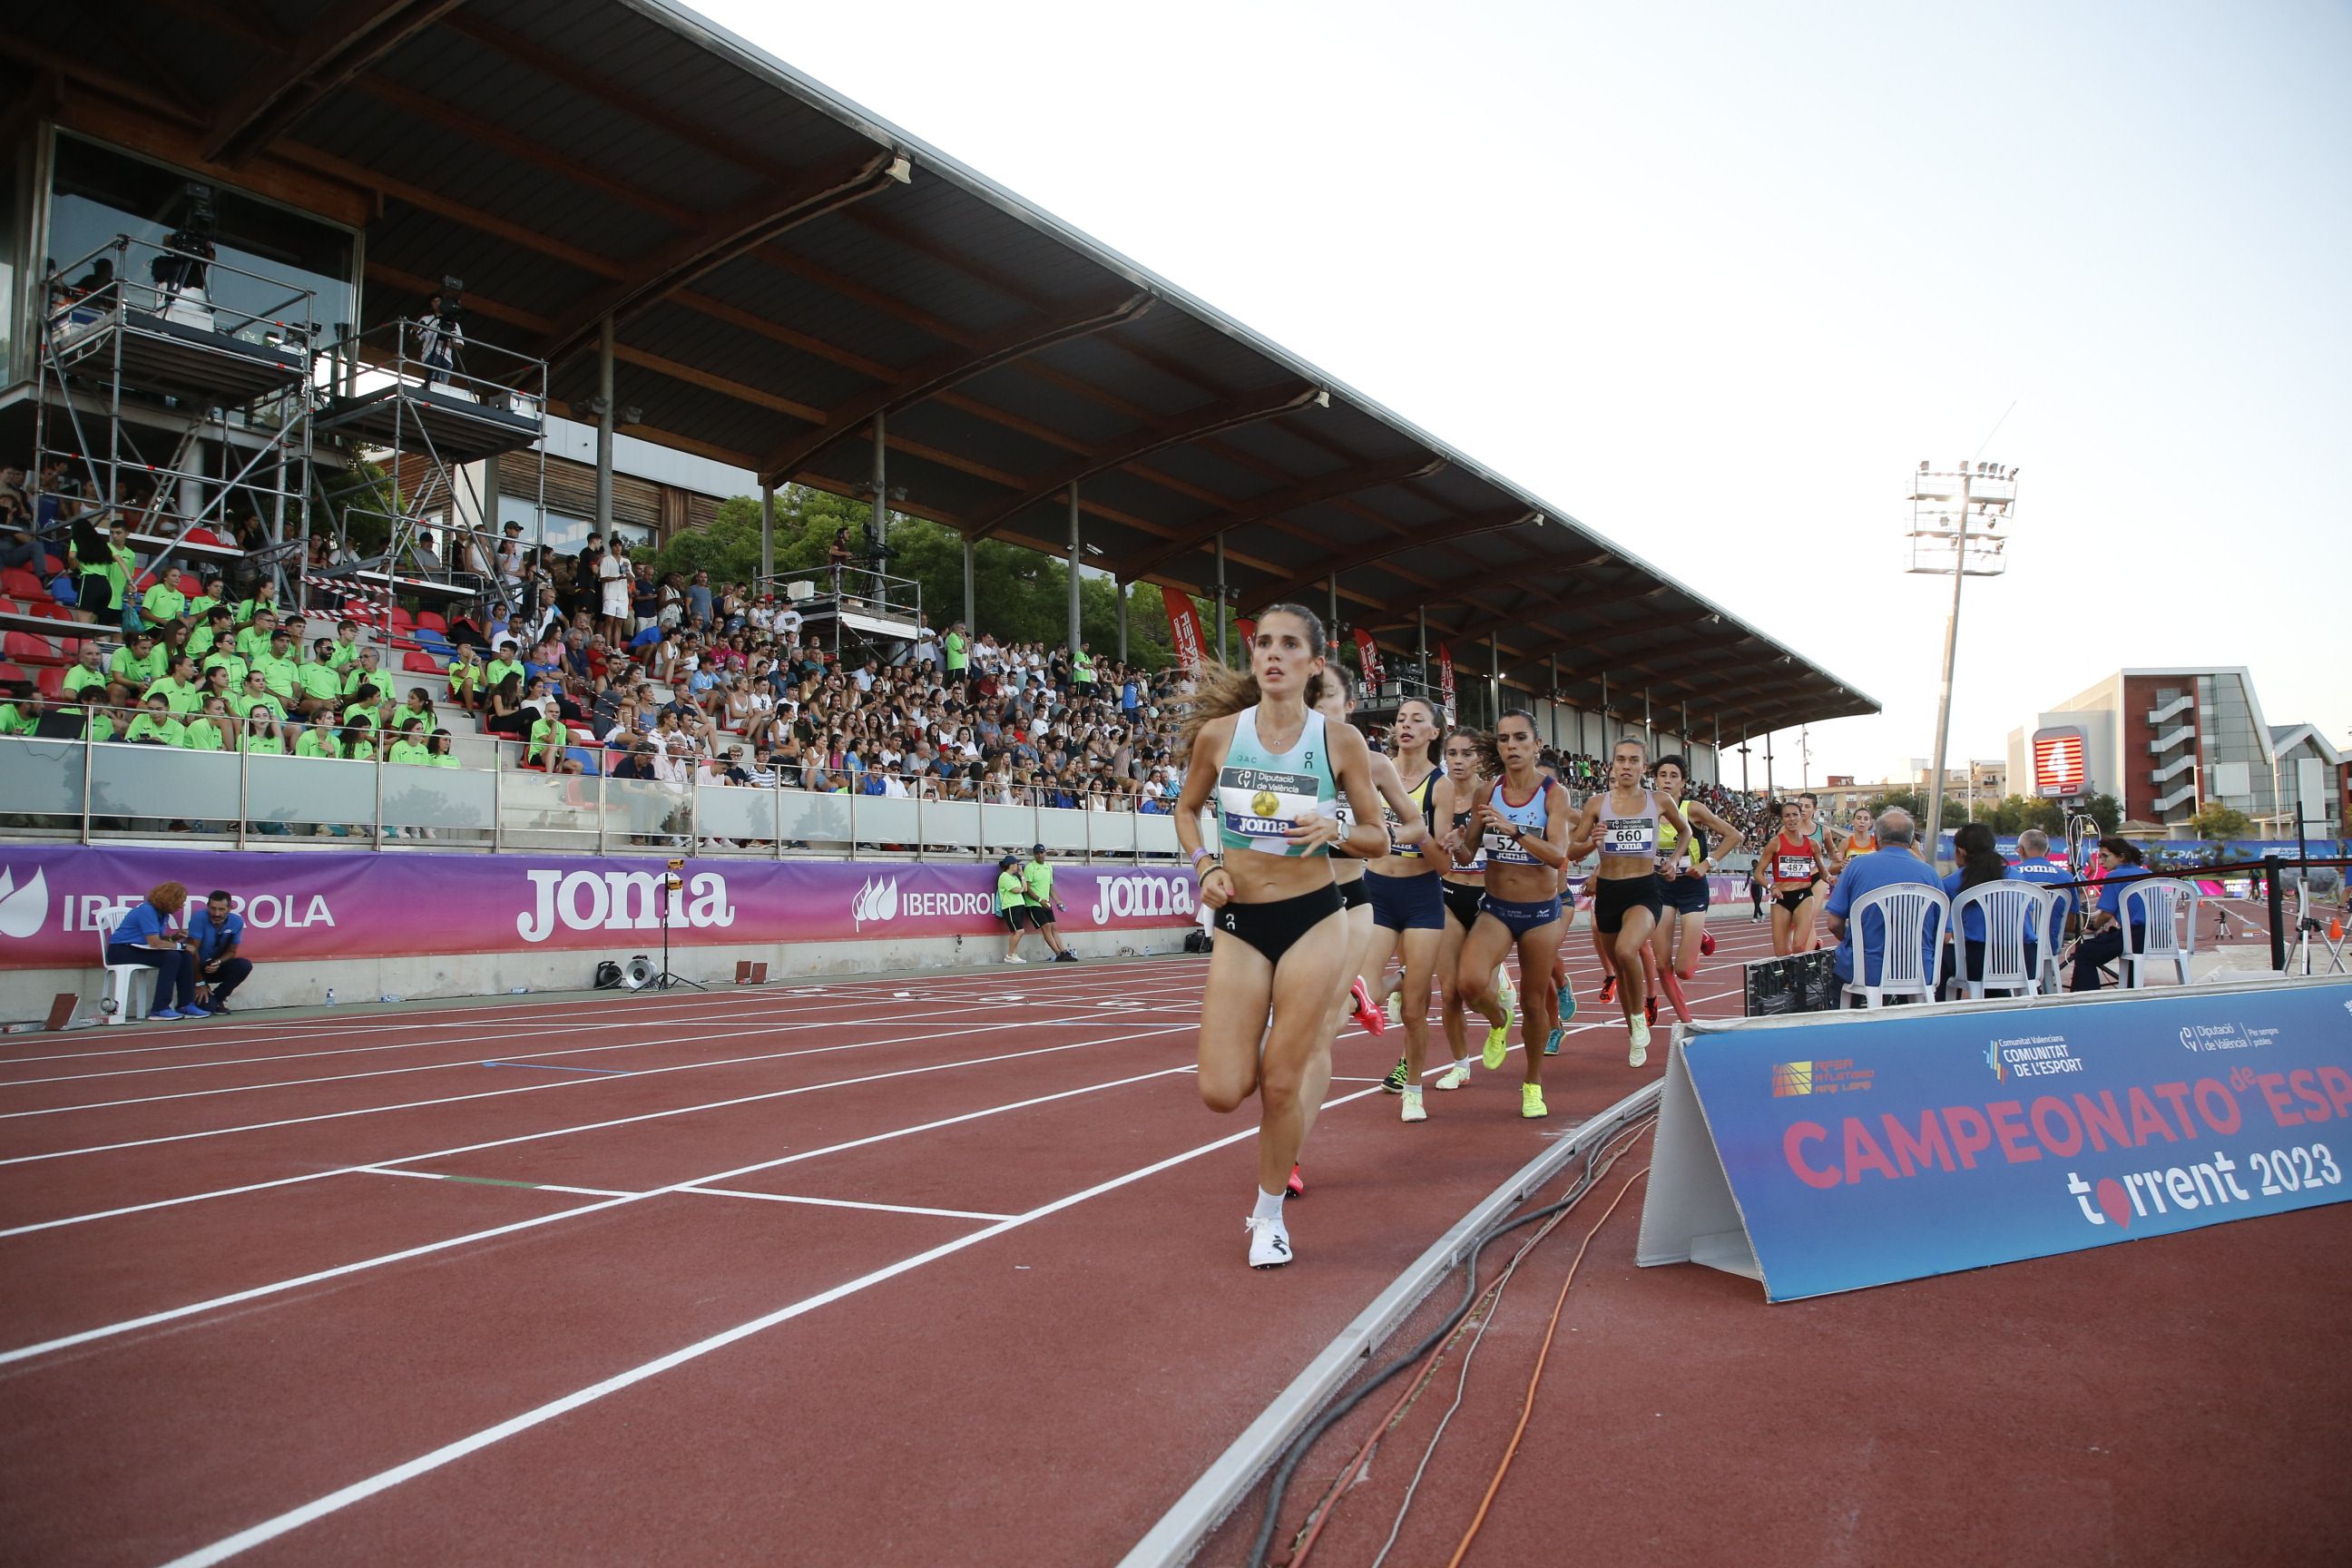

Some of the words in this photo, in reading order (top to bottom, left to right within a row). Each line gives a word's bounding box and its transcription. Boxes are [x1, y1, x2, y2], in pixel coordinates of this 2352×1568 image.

[2047, 741, 2070, 782] 4
[1258, 772, 1295, 784] Diputació
[1257, 782, 1268, 790] de
[1268, 784, 1299, 794] València
[1239, 817, 1289, 834] Joma
[1616, 830, 1642, 842] 660
[1497, 837, 1524, 851] 52
[1615, 842, 1643, 851] Joma
[1495, 852, 1529, 861] Joma
[1787, 864, 1804, 872] 487
[2018, 865, 2058, 874] Joma
[516, 869, 736, 943] Joma
[1092, 875, 1195, 926] Joma
[2196, 1023, 2235, 1038] Diputació
[2248, 1028, 2259, 1036] Per
[2259, 1027, 2279, 1037] sempre
[1998, 1037, 2032, 1047] Comunitat
[2031, 1034, 2065, 1044] Valenciana
[2204, 1041, 2216, 1052] de
[2216, 1037, 2249, 1051] València
[2003, 1044, 2070, 1063] COMUNITAT
[2014, 1063, 2033, 1078] DE
[2032, 1057, 2083, 1076] L'ESPORT
[1783, 1077, 2241, 1190] CAMPEONATO
[2229, 1064, 2259, 1093] de
[2249, 1142, 2342, 1196] 2023
